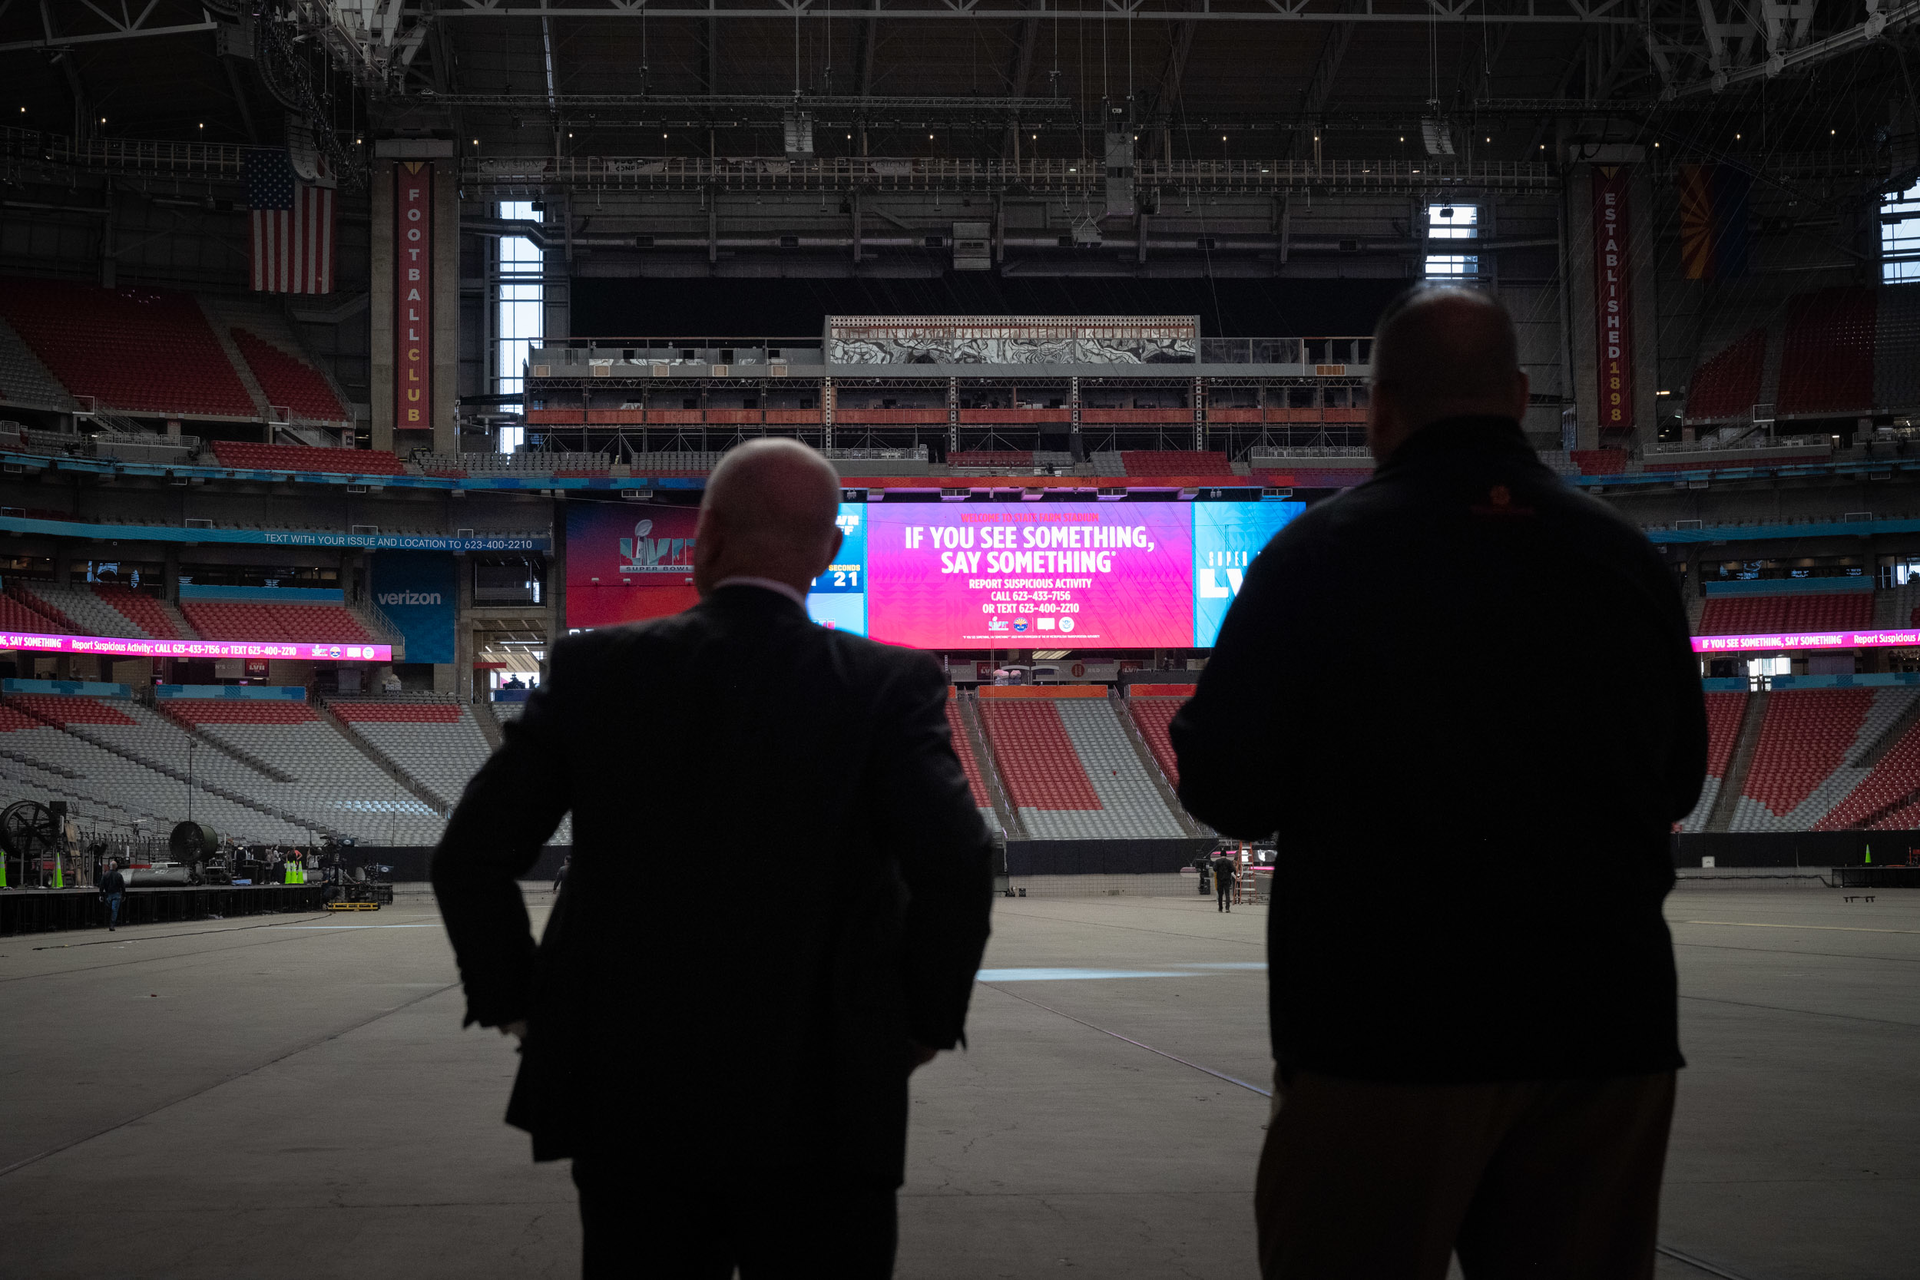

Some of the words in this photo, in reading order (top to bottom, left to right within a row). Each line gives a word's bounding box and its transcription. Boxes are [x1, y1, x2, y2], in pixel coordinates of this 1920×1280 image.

[407, 188, 421, 341] FOOTBALL
[1604, 192, 1621, 359] ESTABLISHED
[407, 348, 421, 422] CLUB
[1609, 361, 1622, 421] 1898
[960, 512, 1001, 523] WELCOME
[1002, 512, 1013, 523] TO
[1014, 512, 1038, 523] STATE
[1039, 512, 1061, 523] FARM
[1063, 512, 1099, 523] STADIUM
[264, 533, 288, 543] TEXT
[290, 535, 315, 544] WITH
[318, 536, 345, 545] YOUR
[347, 537, 375, 546] ISSUE
[377, 538, 398, 547] AND
[399, 539, 446, 548] LOCATION
[448, 540, 461, 549] TO
[464, 540, 533, 549] 623-400-2210
[905, 526, 924, 549] IF
[929, 526, 975, 549] YOU
[980, 526, 1018, 549] SEE
[1022, 526, 1155, 553] SOMETHING,
[941, 551, 982, 574] SAY
[1208, 551, 1248, 567] SUPER
[828, 564, 861, 572] SECONDS
[834, 571, 858, 587] 21
[968, 578, 1002, 589] REPORT
[1003, 578, 1053, 589] SUSPICIOUS
[1054, 578, 1092, 589] ACTIVITY
[377, 589, 442, 605] verizon
[991, 591, 1011, 601] CALL
[1012, 591, 1071, 601] 623-433-7156
[982, 603, 995, 613] OR
[996, 603, 1017, 613] TEXT
[1018, 603, 1080, 613] 623-400-2210
[10, 636, 23, 646] SAY
[72, 640, 93, 650] Report
[94, 641, 126, 652] Suspicious
[127, 643, 153, 654] Activity:
[155, 643, 171, 653] CALL
[172, 644, 220, 654] 623-433-7156
[221, 646, 229, 654] or
[230, 645, 247, 655] TEXT
[248, 646, 297, 656] 623-400-2210
[1702, 639, 1710, 649] IF
[1710, 639, 1725, 648] YOU
[1726, 638, 1739, 648] SEE
[1740, 637, 1784, 648] SOMETHING,
[1785, 636, 1799, 646] SAY
[1854, 634, 1878, 645] Report
[1879, 633, 1916, 643] Suspicious
